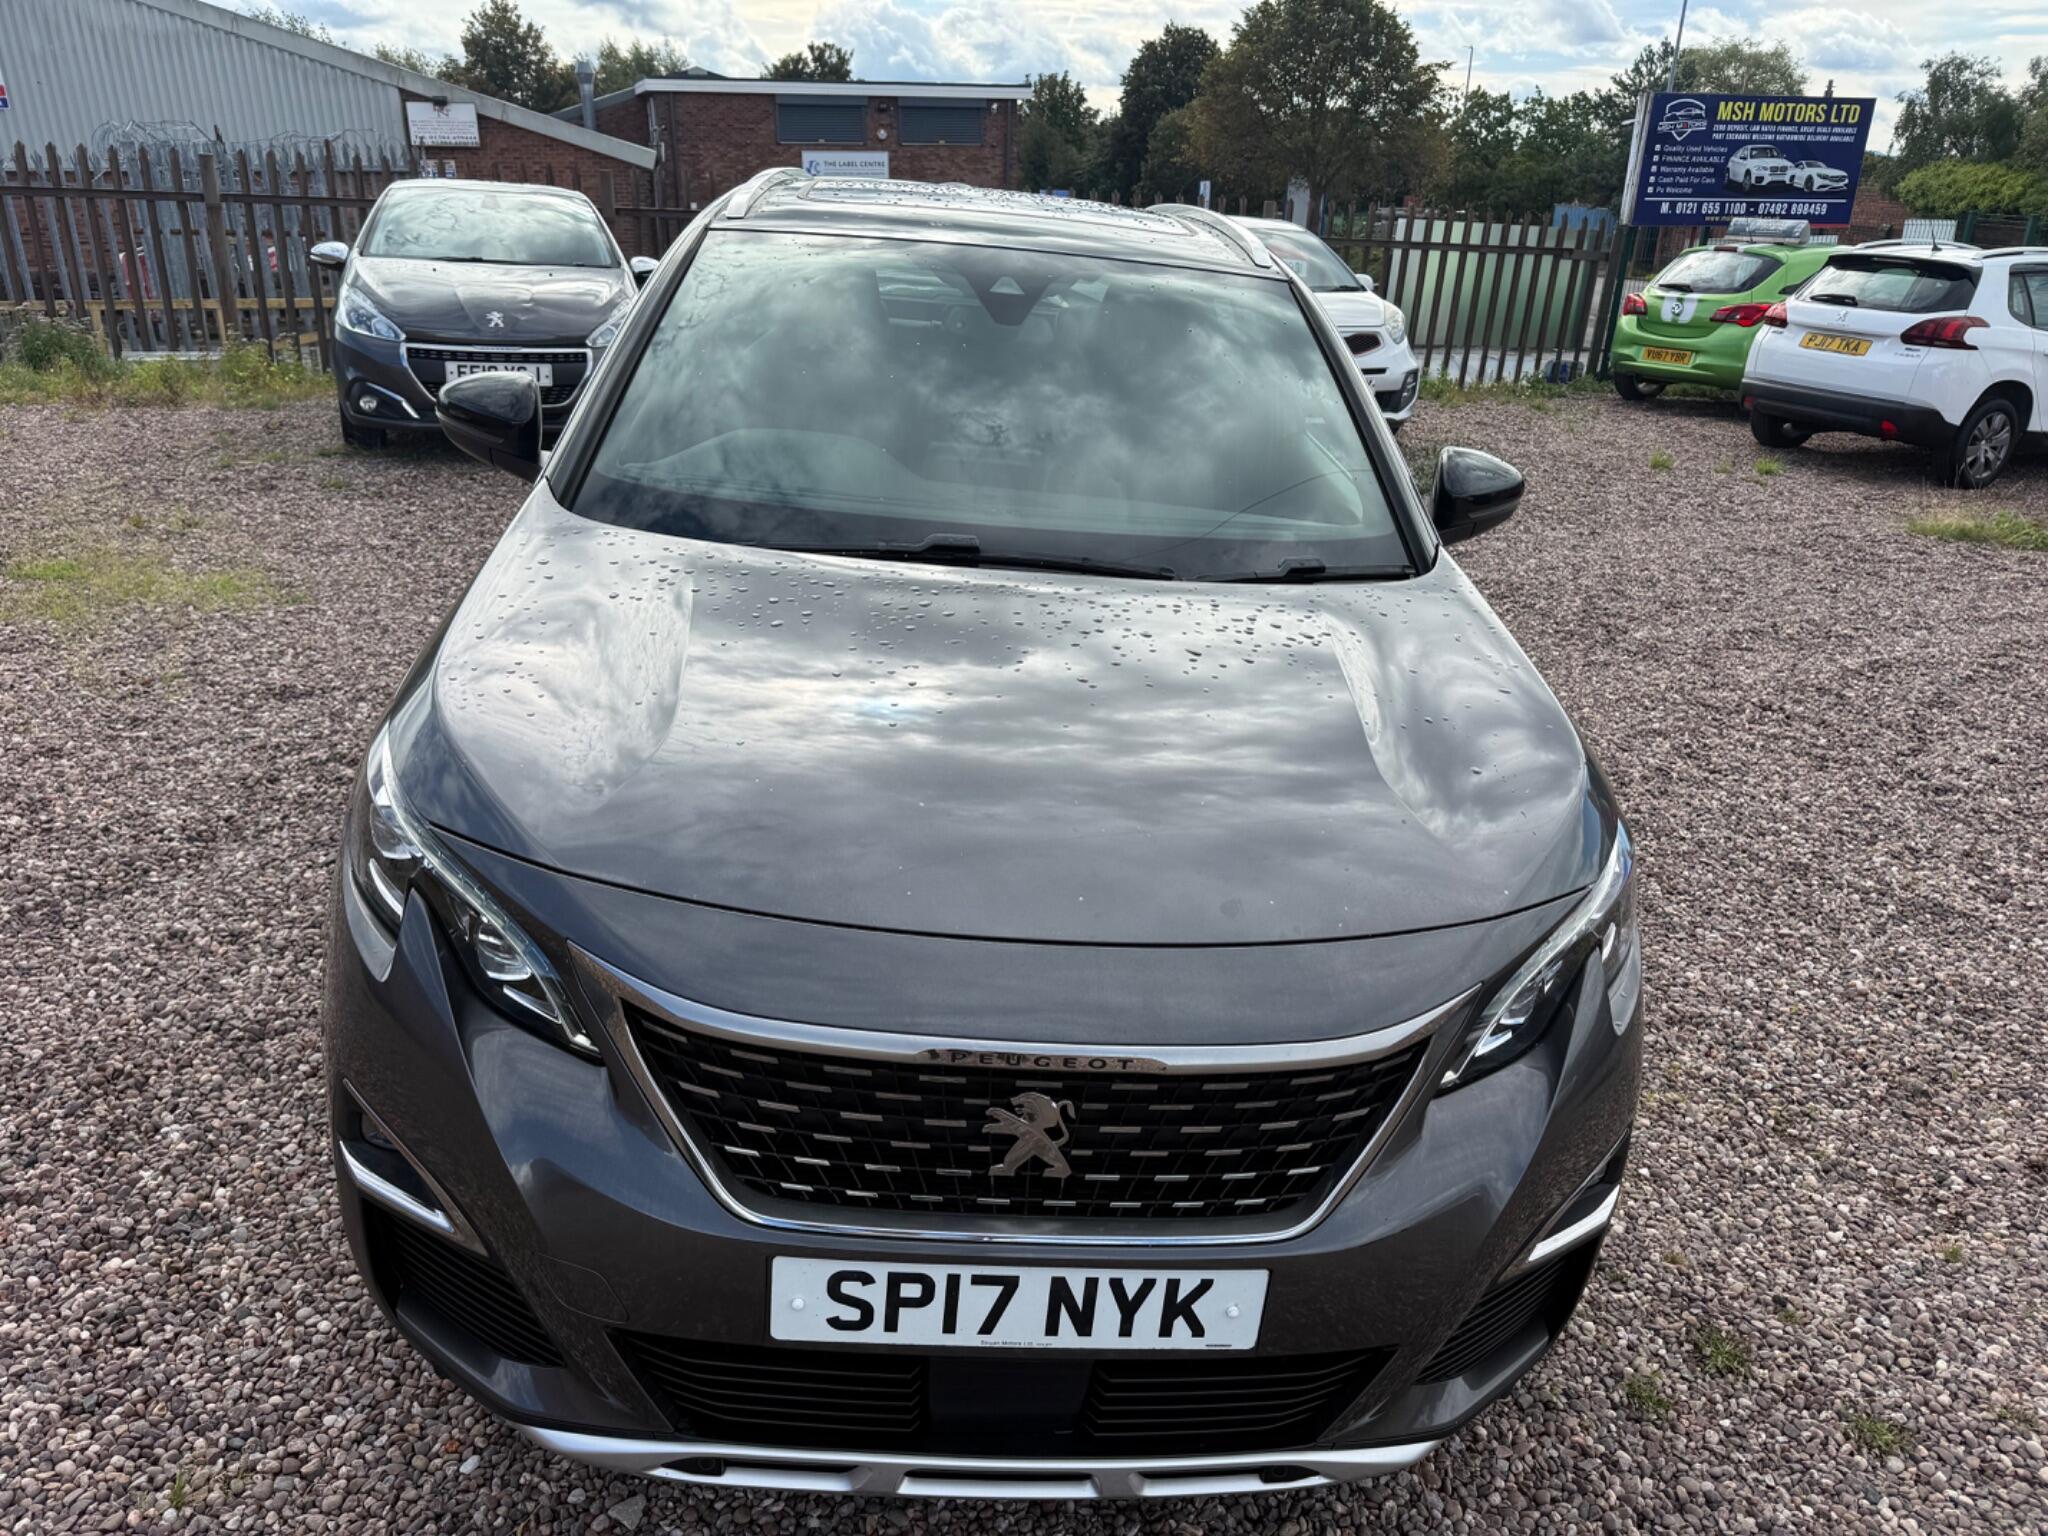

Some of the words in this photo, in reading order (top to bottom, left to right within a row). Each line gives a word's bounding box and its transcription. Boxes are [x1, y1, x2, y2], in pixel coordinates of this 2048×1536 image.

[1717, 101, 1756, 121] MSH
[1758, 102, 1827, 123] MOTORS
[1830, 104, 1861, 124] LTD
[1663, 145, 1685, 153] Quality
[1703, 145, 1728, 153] Vehicles
[824, 160, 837, 168] THE
[839, 160, 858, 168] LABEL
[859, 160, 885, 168] CENTRE
[1691, 155, 1726, 163] AVAILABLE
[1660, 165, 1687, 174] Warranty
[1701, 176, 1715, 184] Cars
[1676, 202, 1698, 214] 0121
[1701, 202, 1720, 214] 655
[1724, 202, 1747, 214] 1100
[1758, 203, 1788, 215] 07492
[1806, 334, 1834, 348] PJ17
[1837, 337, 1861, 352] TKA
[950, 1051, 1135, 1071] PEUGEOT
[825, 1269, 1021, 1336] SP17
[1044, 1275, 1215, 1338] NYK
